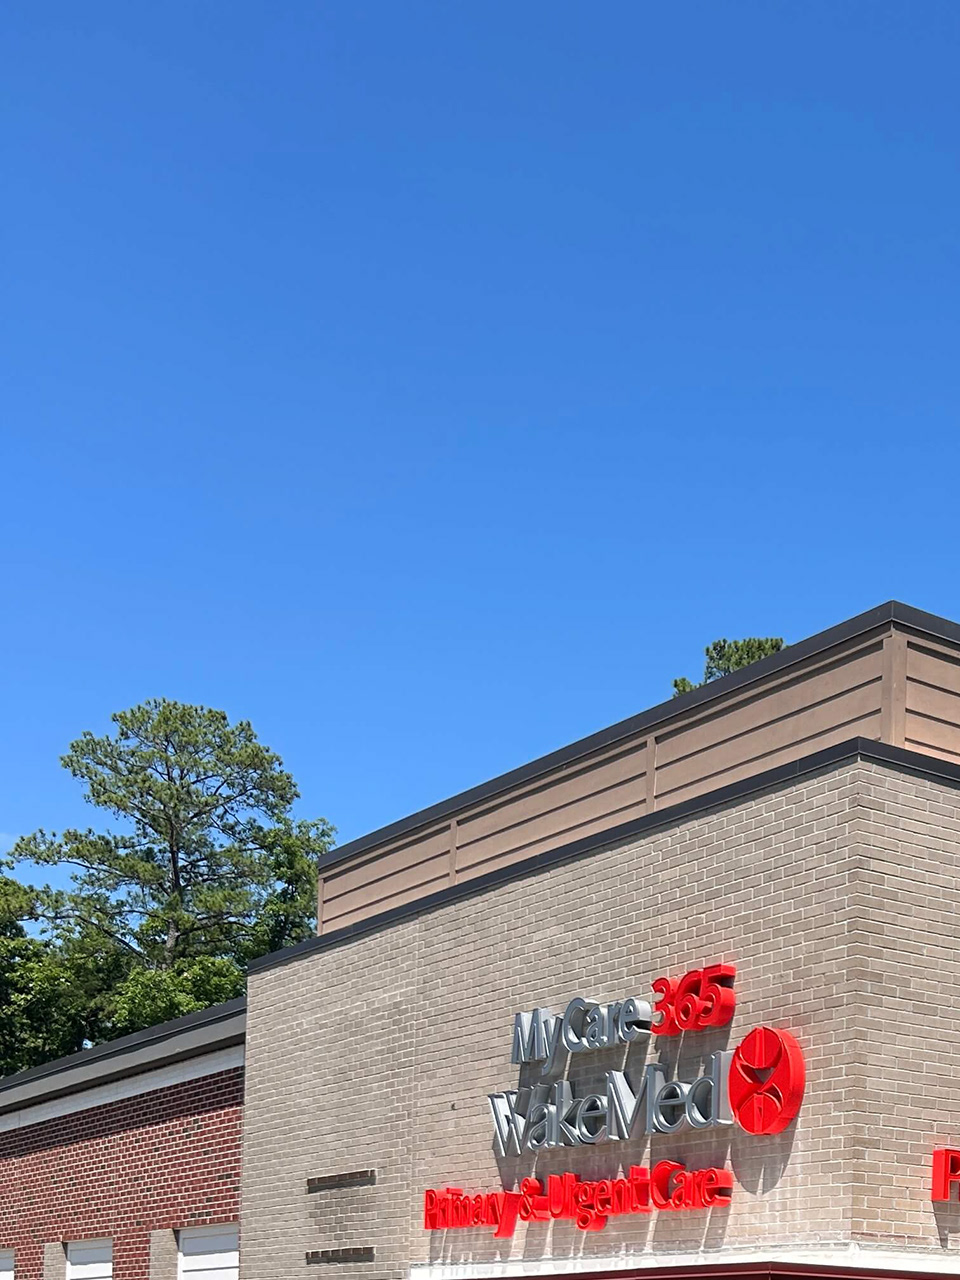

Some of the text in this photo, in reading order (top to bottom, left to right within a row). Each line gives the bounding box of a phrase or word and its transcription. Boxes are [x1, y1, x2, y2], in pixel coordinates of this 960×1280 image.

[511, 964, 736, 1076] MyCare 365
[487, 1049, 736, 1157] WakeMed
[424, 1159, 733, 1238] Primary & Urgent Care
